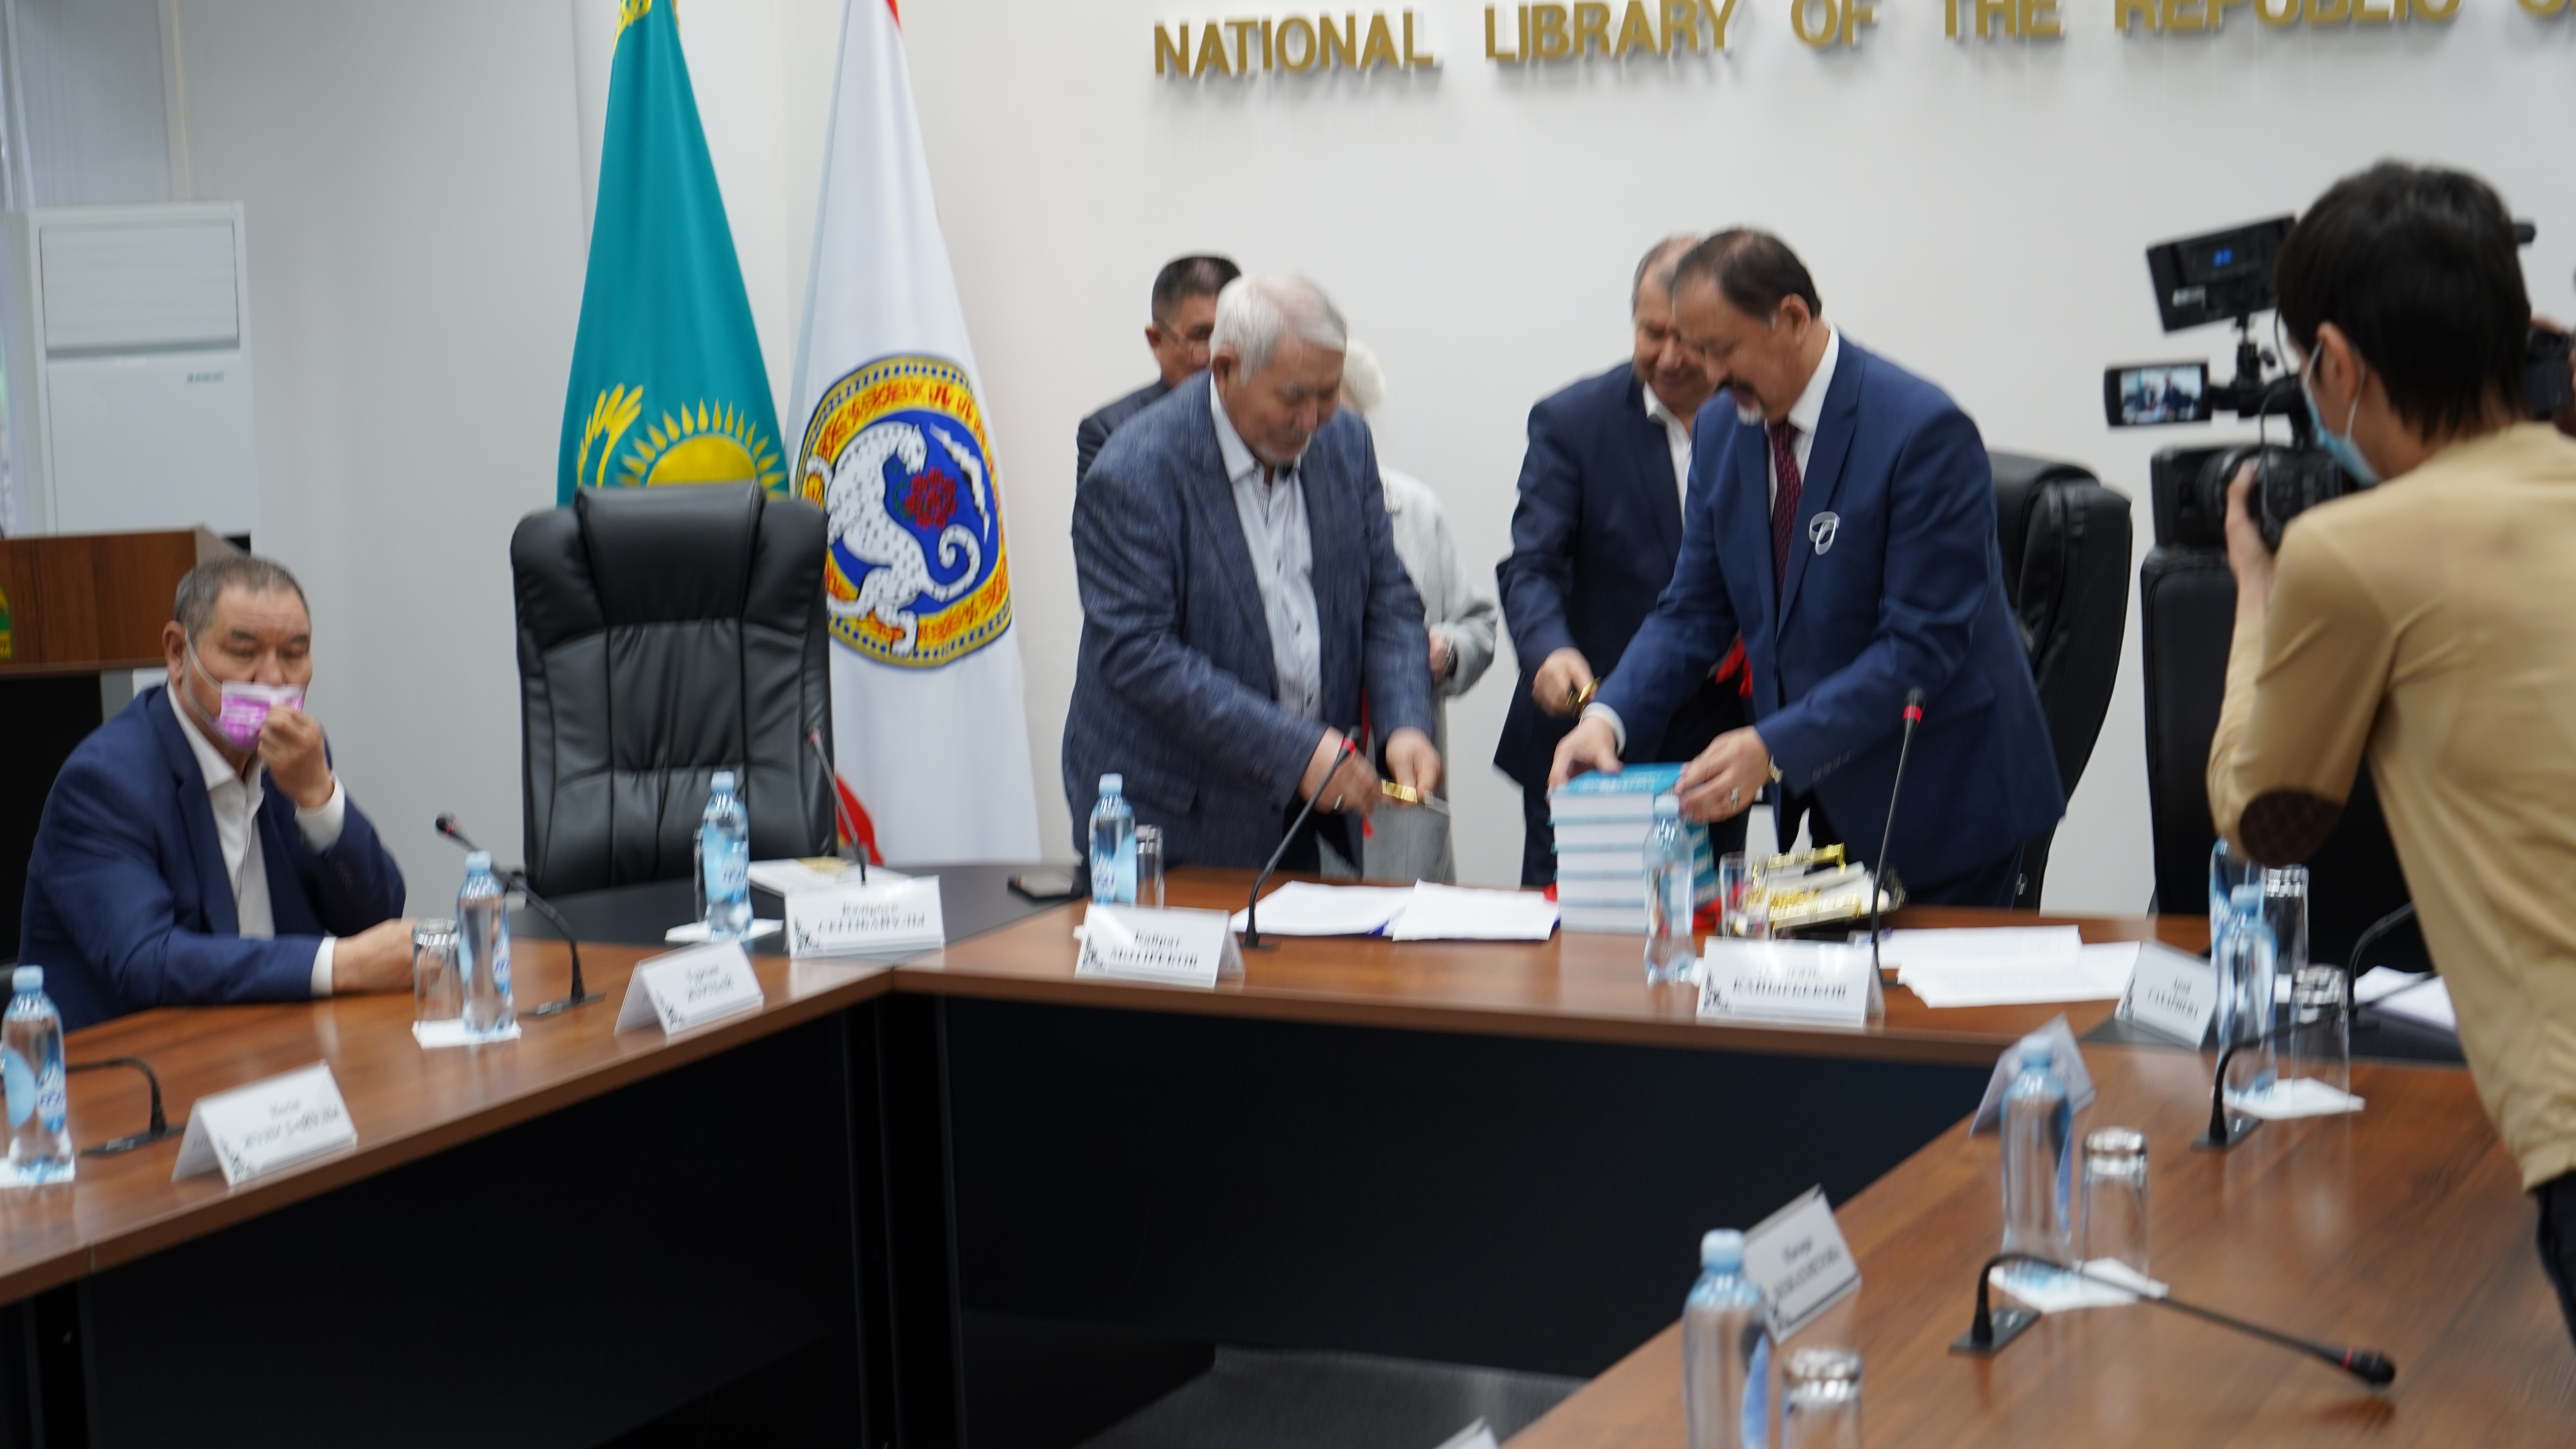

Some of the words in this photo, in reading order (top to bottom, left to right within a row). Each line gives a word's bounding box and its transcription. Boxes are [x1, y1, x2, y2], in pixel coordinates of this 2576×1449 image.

[1154, 10, 1435, 76] NATIONAL
[1485, 0, 1737, 61] LIBRARY
[1791, 0, 1874, 47] OF
[1944, 0, 2061, 39] THE
